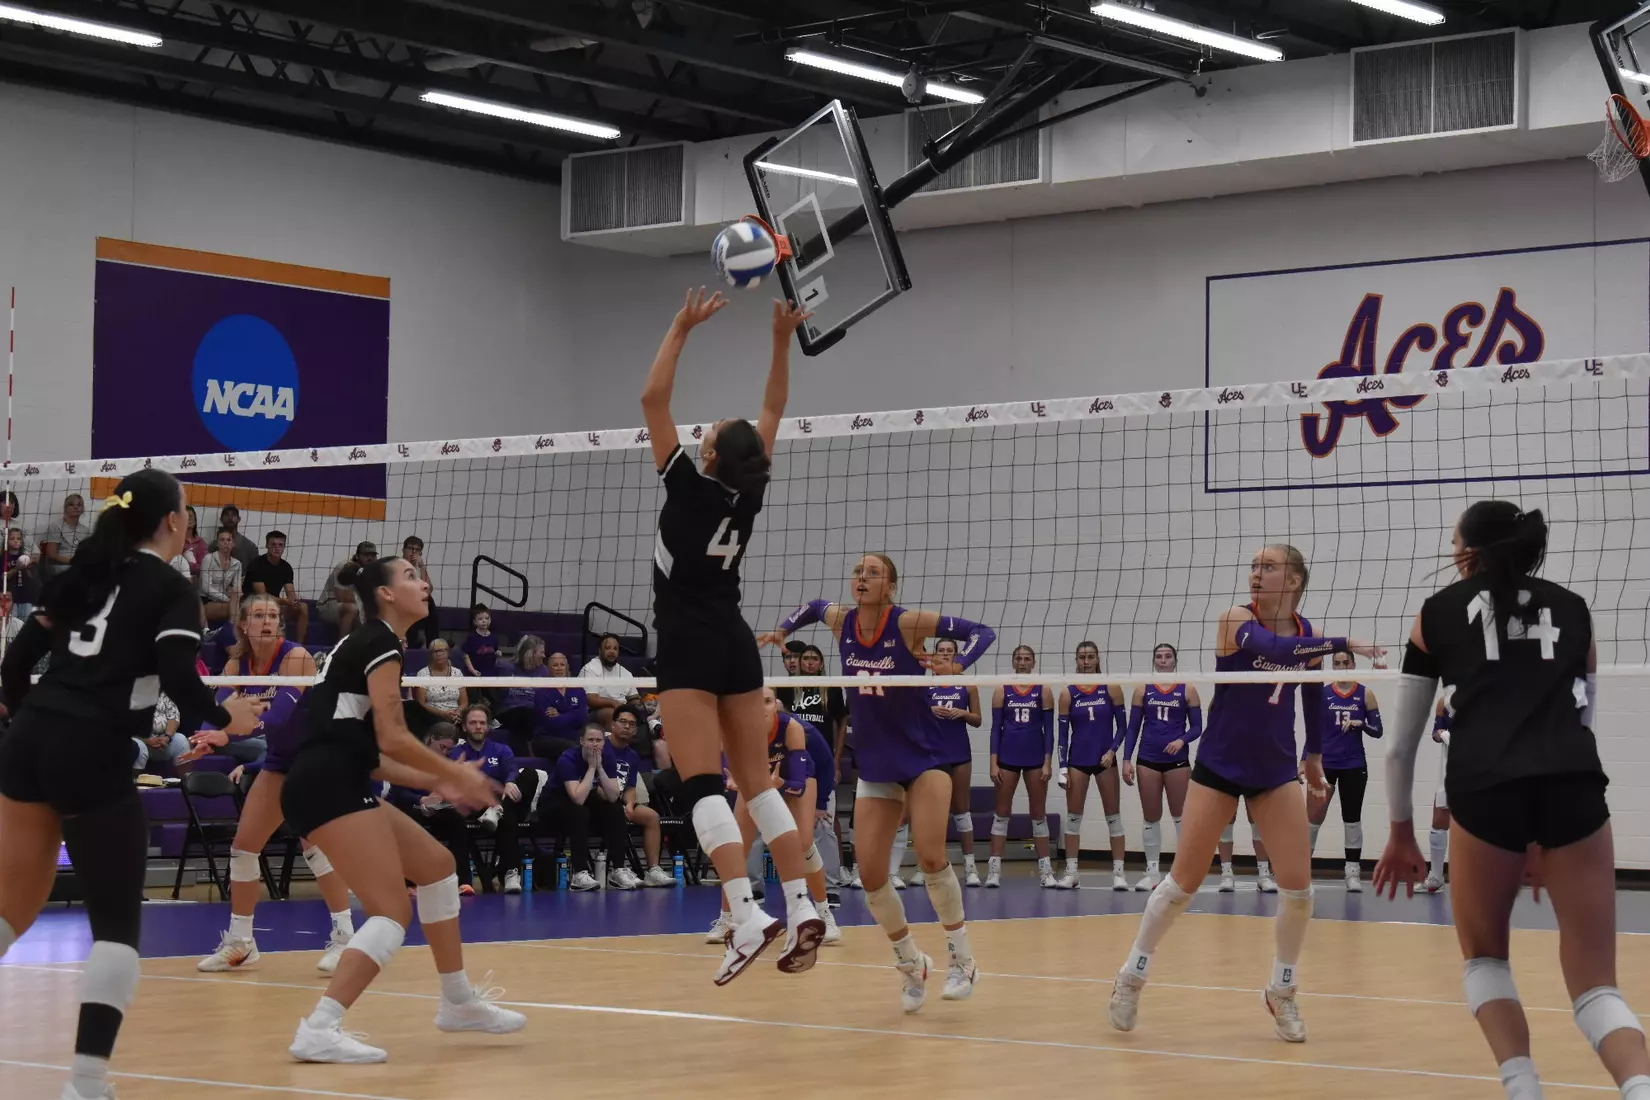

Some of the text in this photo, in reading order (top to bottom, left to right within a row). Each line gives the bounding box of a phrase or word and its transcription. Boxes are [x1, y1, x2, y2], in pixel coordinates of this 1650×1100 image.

[1301, 287, 1545, 458] Aces
[203, 379, 295, 422] NCAA
[348, 447, 367, 460] Aces
[398, 444, 409, 457] UE
[440, 441, 460, 455] Aces
[535, 436, 554, 450] Aces
[588, 432, 600, 446] UE
[798, 419, 812, 433] UE
[851, 415, 873, 430] Aces
[965, 407, 989, 422] Aces
[1031, 402, 1046, 417] UE
[1089, 398, 1114, 414] Aces
[1218, 387, 1244, 404] Aces
[1291, 382, 1308, 398] UE
[1356, 377, 1384, 394] Aces
[1501, 365, 1530, 383] Aces
[1585, 359, 1603, 376] UE
[706, 517, 741, 570] 4
[1466, 590, 1561, 661] 14
[1293, 640, 1334, 656] Evansville
[846, 653, 895, 670] Evansville
[1007, 700, 1038, 709] Evansville
[1075, 698, 1106, 708] Evansville
[1148, 698, 1180, 708] Evansville
[1328, 702, 1359, 712] Evansville
[1014, 708, 1031, 723] 18
[1087, 707, 1095, 721] 1
[1157, 706, 1169, 722] 11
